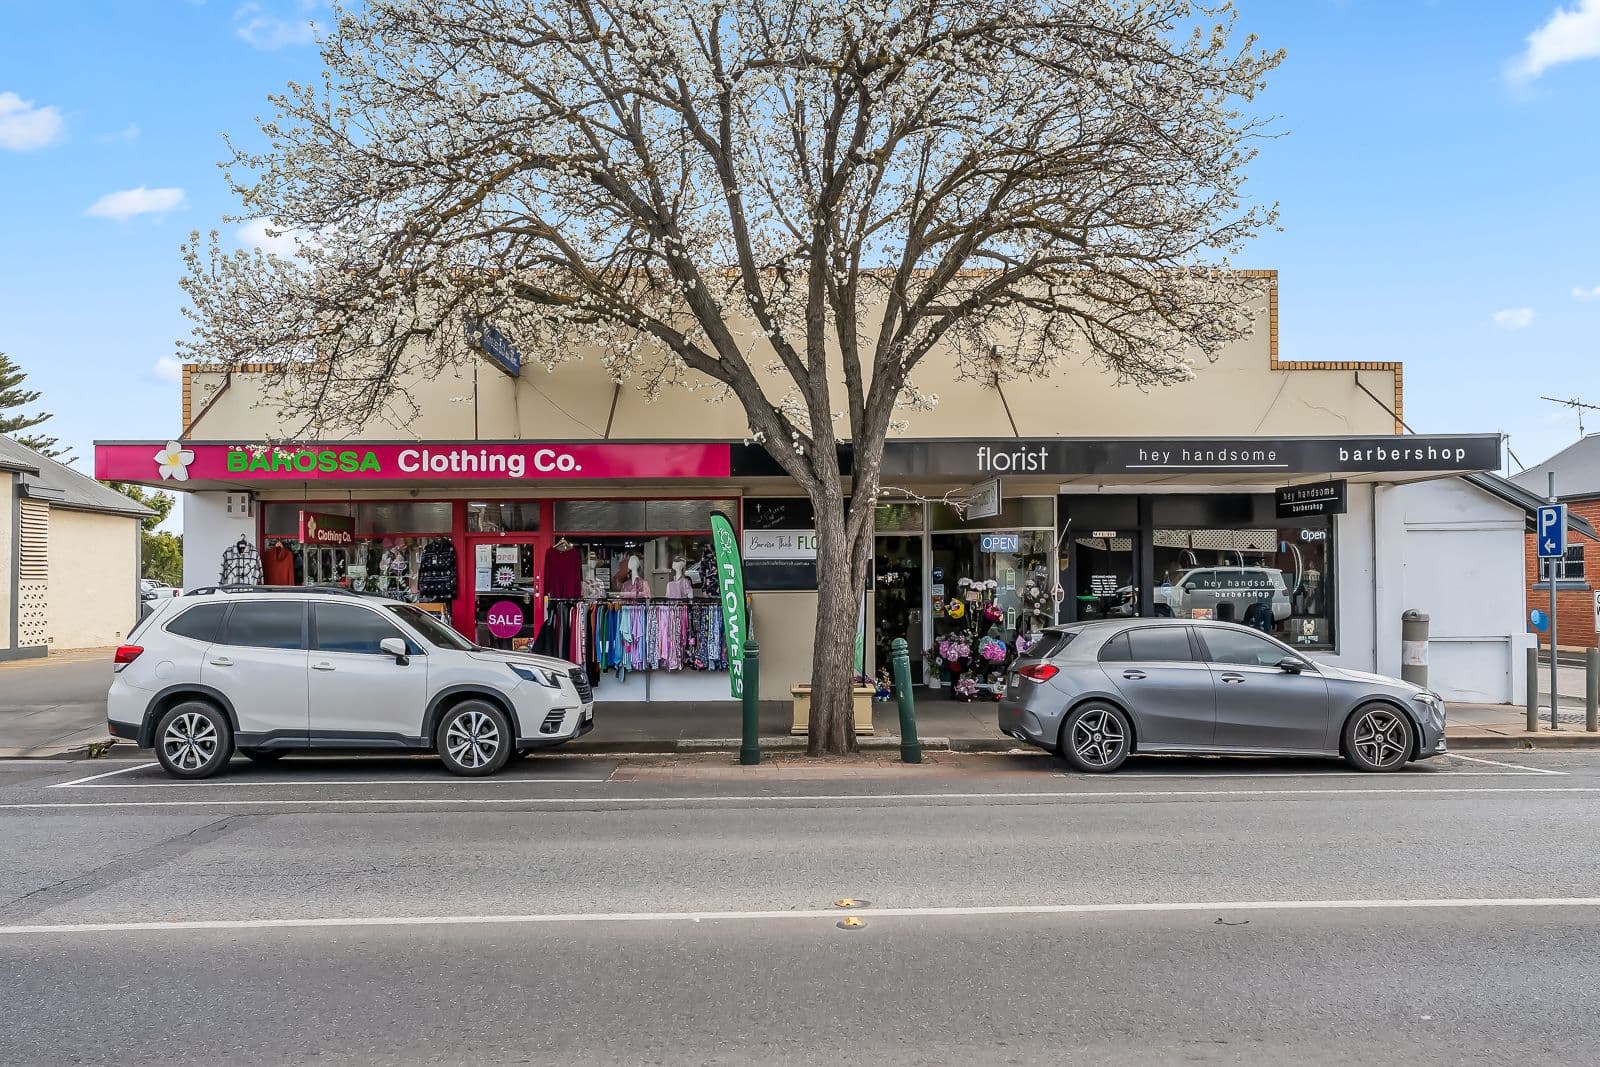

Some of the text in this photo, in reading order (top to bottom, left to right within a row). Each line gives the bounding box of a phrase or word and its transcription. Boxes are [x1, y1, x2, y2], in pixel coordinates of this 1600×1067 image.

[977, 447, 1049, 471] florist
[1139, 449, 1277, 464] hey handsome
[1339, 446, 1466, 462] barbershop
[227, 449, 582, 477] BAROSSA Clothing Co.
[1283, 487, 1335, 502] hey handsome
[1292, 503, 1324, 512] barbershop
[1542, 509, 1557, 537] P
[317, 529, 352, 544] Clothing Co.
[1301, 529, 1326, 541] Open
[982, 537, 1017, 550] OPEN
[1204, 579, 1280, 588] hey handsome
[488, 614, 522, 625] SALE
[723, 563, 744, 695] FLOWERS
